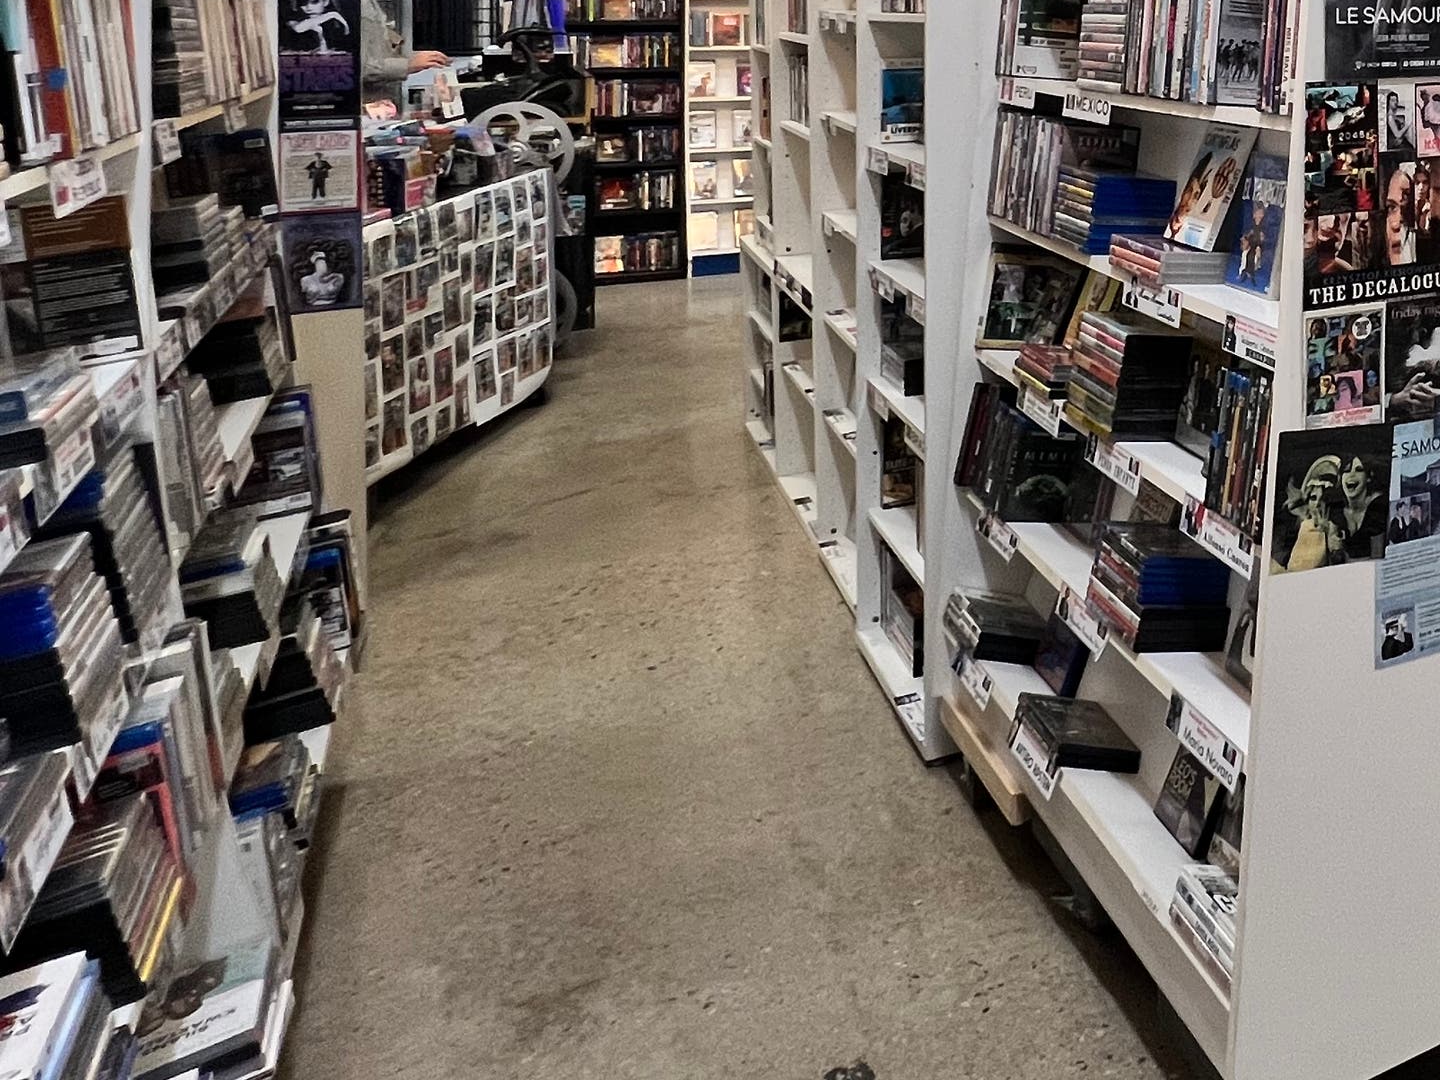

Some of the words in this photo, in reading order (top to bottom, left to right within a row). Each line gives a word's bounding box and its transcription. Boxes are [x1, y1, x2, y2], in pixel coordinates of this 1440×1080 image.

[1336, 7, 1359, 25] LE
[1015, 86, 1032, 100] PERU
[1075, 96, 1109, 116] MEXICO
[1309, 285, 1346, 305] THE
[1391, 305, 1421, 321] friday
[1024, 451, 1074, 462] MIMI
[1178, 758, 1198, 787] LEO'S
[1204, 747, 1234, 787] Novaro
